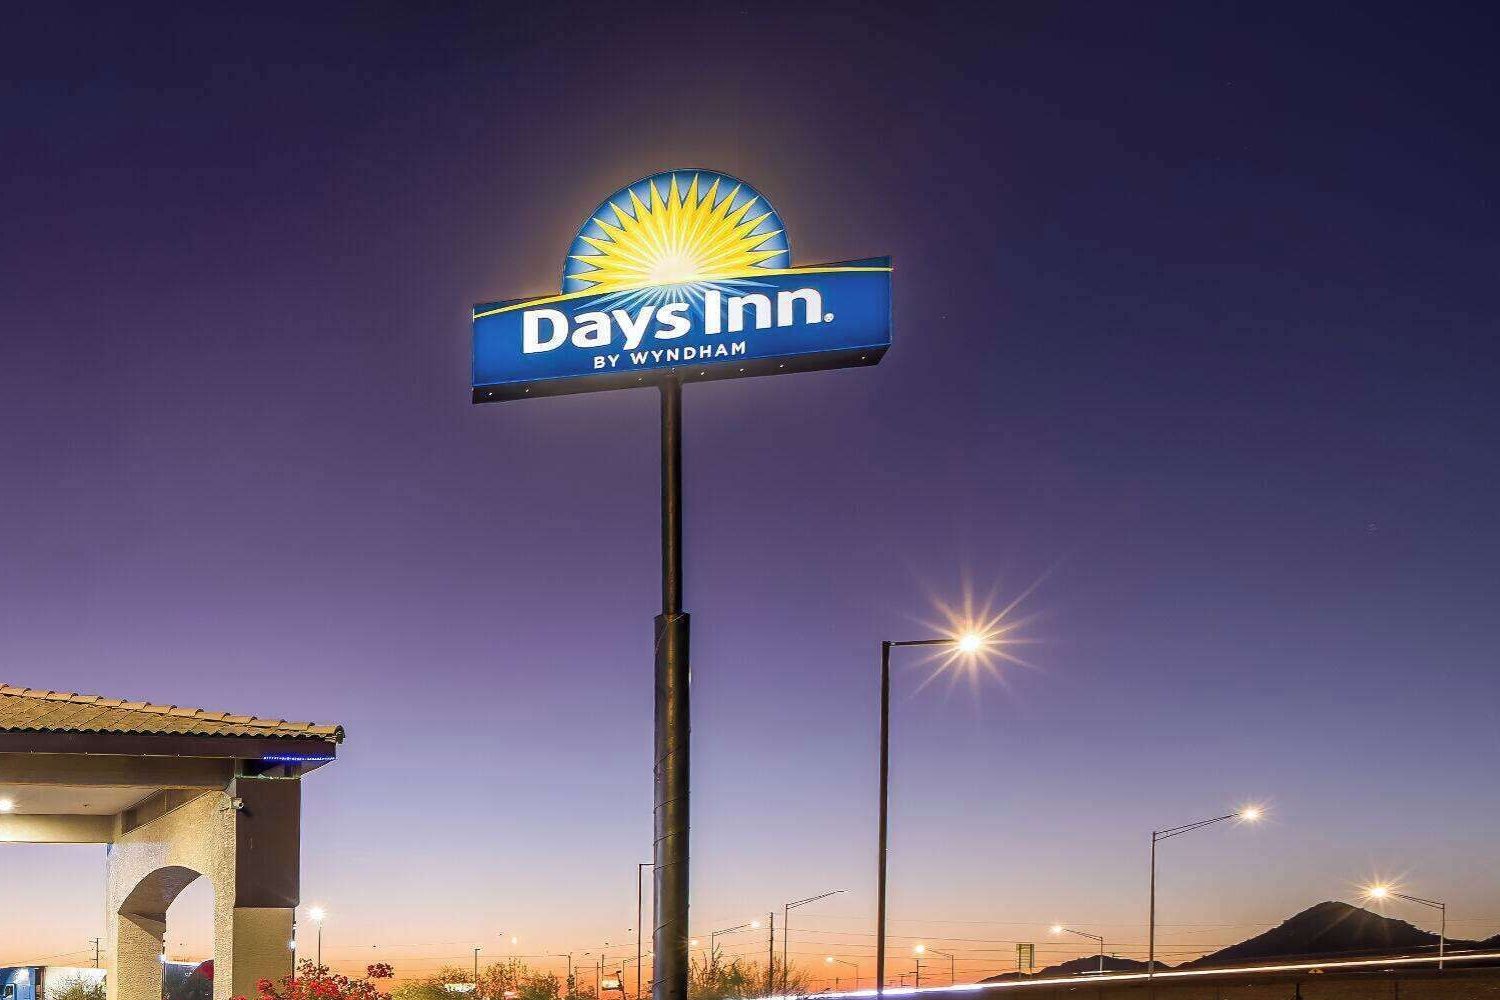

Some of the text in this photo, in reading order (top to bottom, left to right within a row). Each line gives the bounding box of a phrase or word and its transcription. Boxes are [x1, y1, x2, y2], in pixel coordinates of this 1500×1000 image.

[523, 302, 690, 353] Days
[594, 341, 746, 369] BY WYNDHAM
